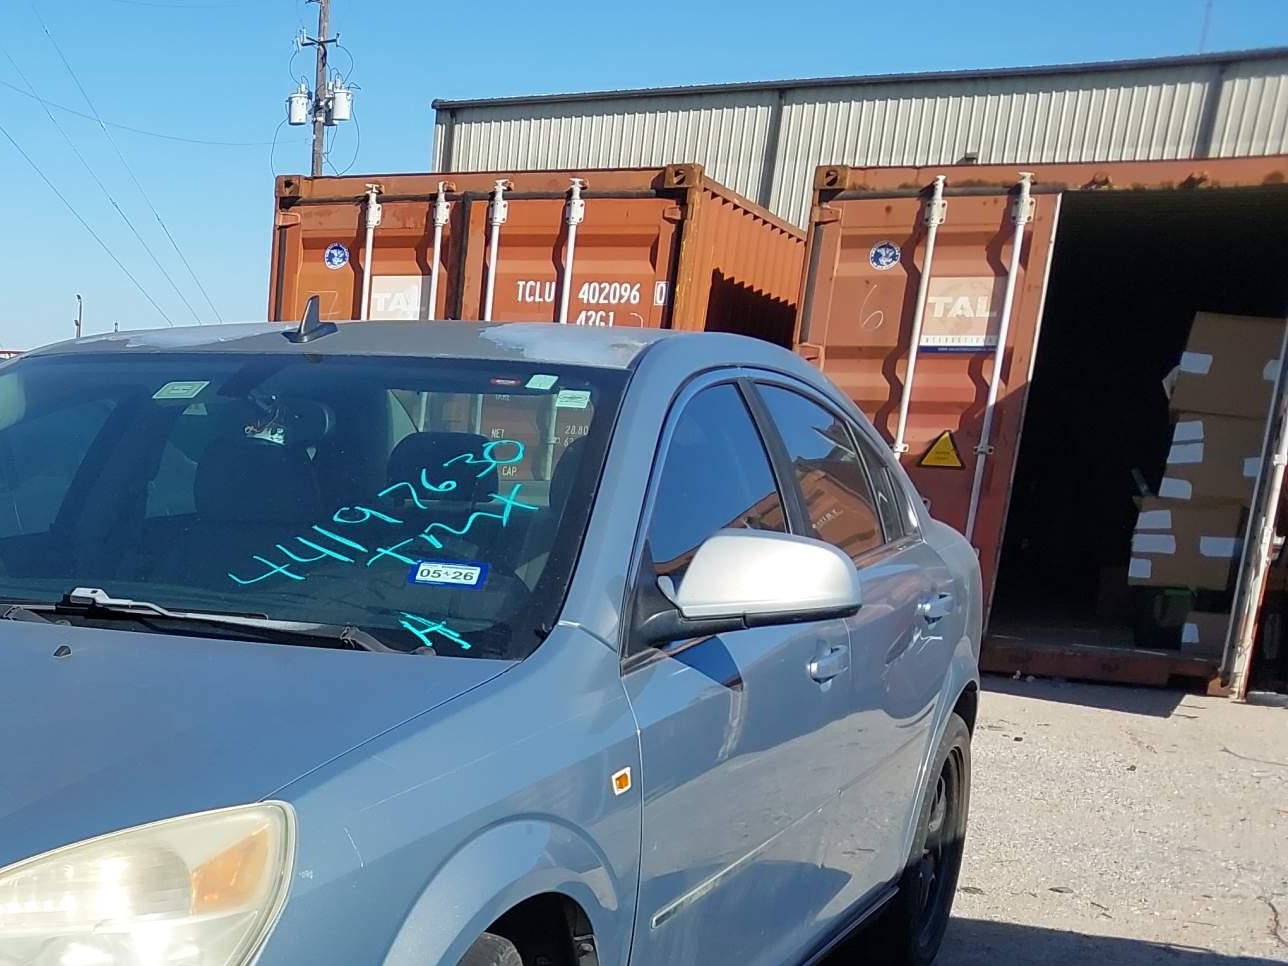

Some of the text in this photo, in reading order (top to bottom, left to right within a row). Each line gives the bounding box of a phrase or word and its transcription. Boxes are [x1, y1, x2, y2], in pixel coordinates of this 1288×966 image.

[516, 280, 667, 305] TCLU 402096 0
[927, 295, 998, 318] TAL
[490, 428, 506, 440] NET
[227, 439, 525, 584] 44197630
[399, 611, 471, 649] A
